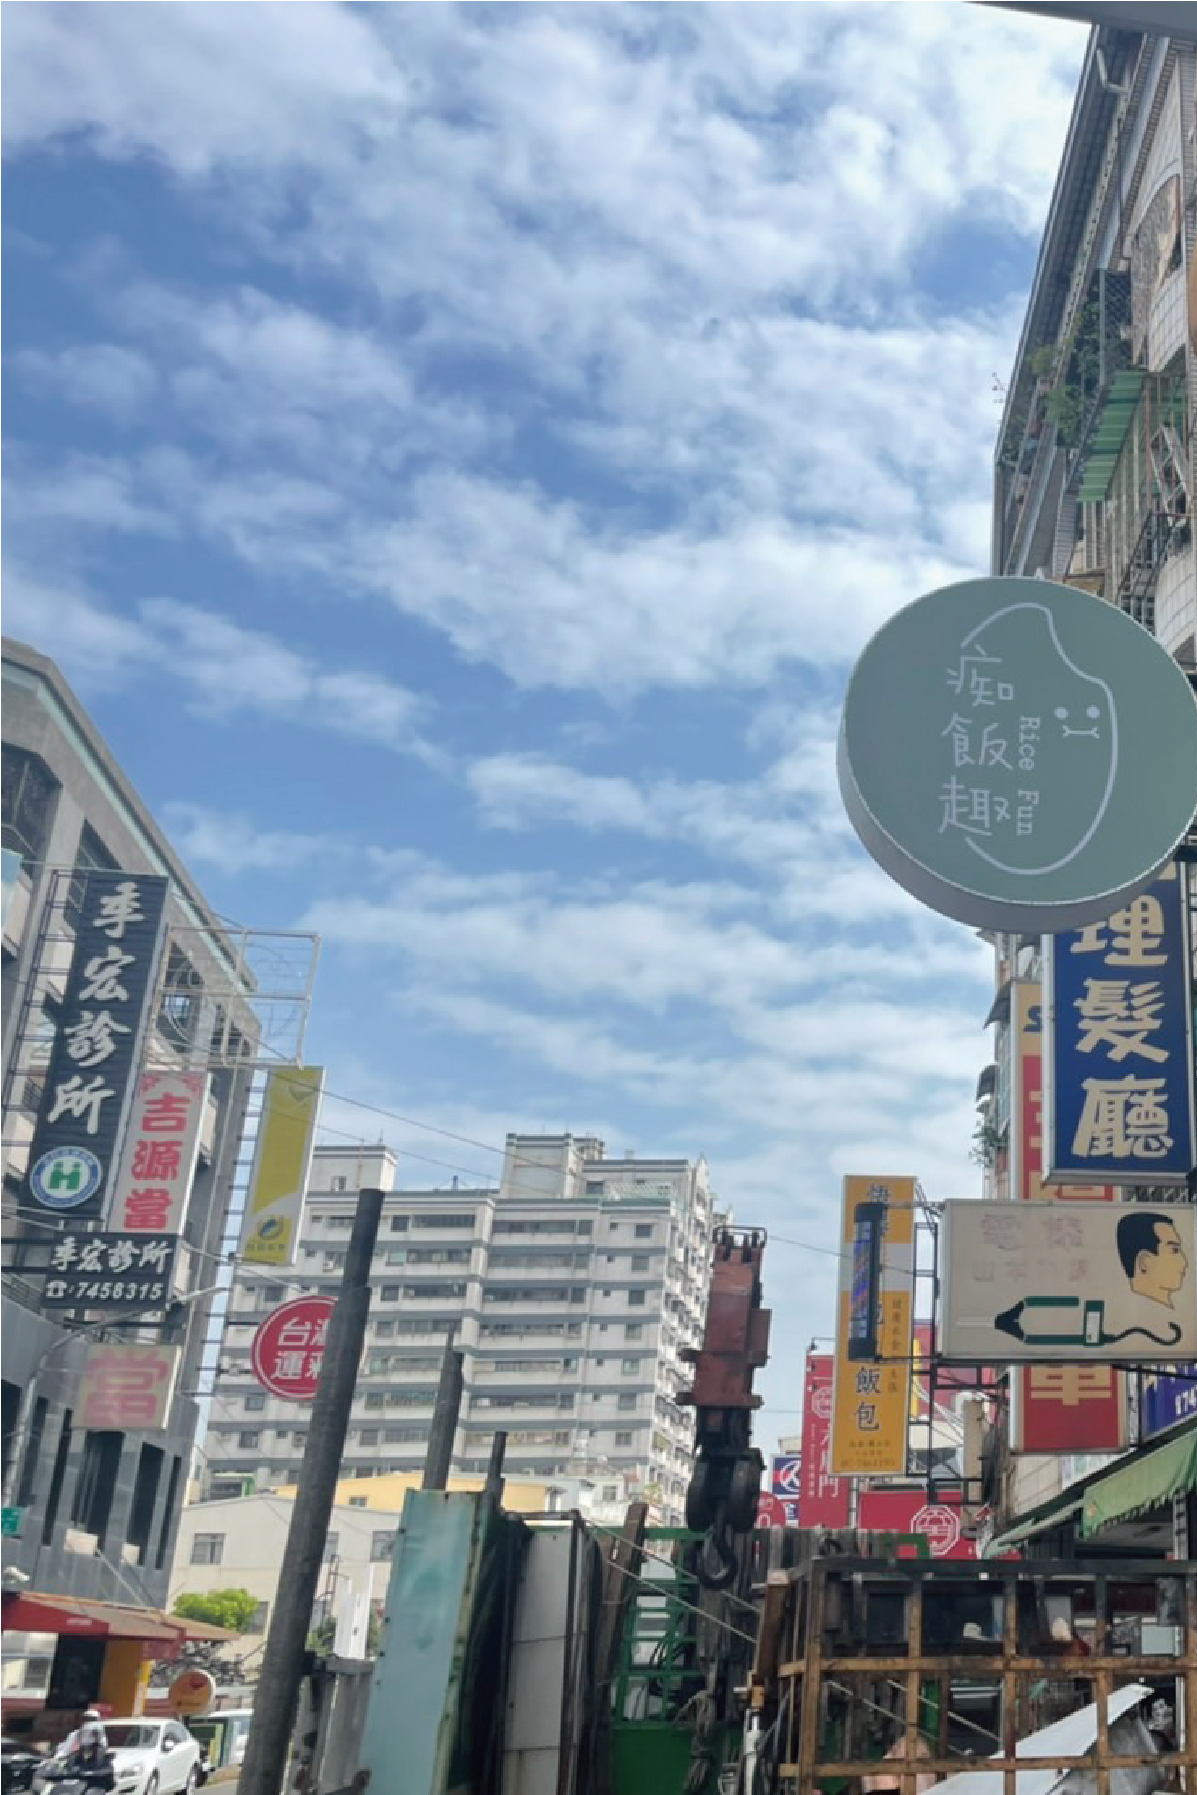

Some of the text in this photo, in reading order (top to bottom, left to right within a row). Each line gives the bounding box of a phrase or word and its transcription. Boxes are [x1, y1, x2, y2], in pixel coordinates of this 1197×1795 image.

[938, 643, 1014, 835] 痴飯趣
[1016, 716, 1041, 836] Rice Fun
[1069, 895, 1174, 1160] 理髮廳
[124, 1092, 191, 1230] 吉源當
